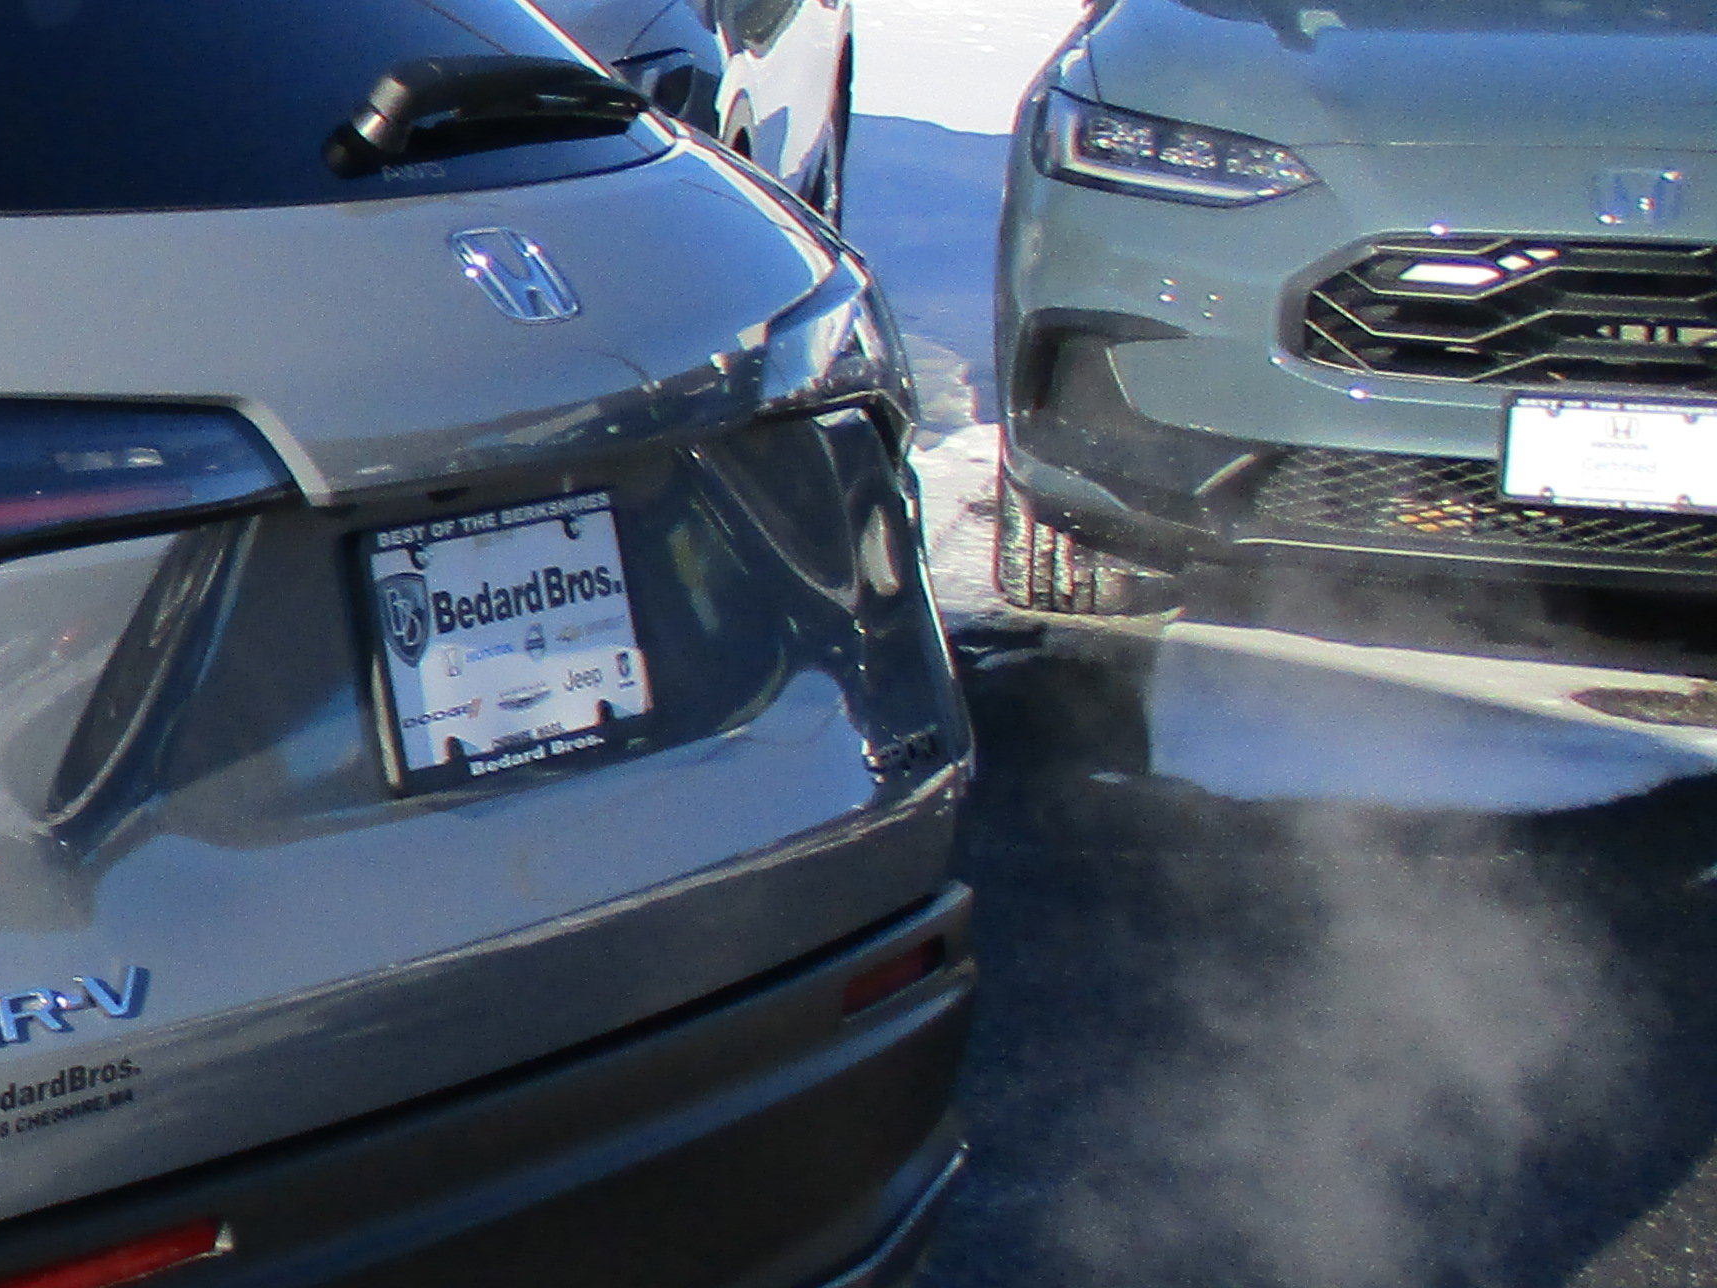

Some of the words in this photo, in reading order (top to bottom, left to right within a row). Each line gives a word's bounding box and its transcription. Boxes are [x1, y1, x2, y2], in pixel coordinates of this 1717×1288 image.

[377, 526, 426, 548] BEST
[430, 520, 456, 539] OF
[461, 513, 497, 533] THE
[563, 666, 604, 692] Jeep
